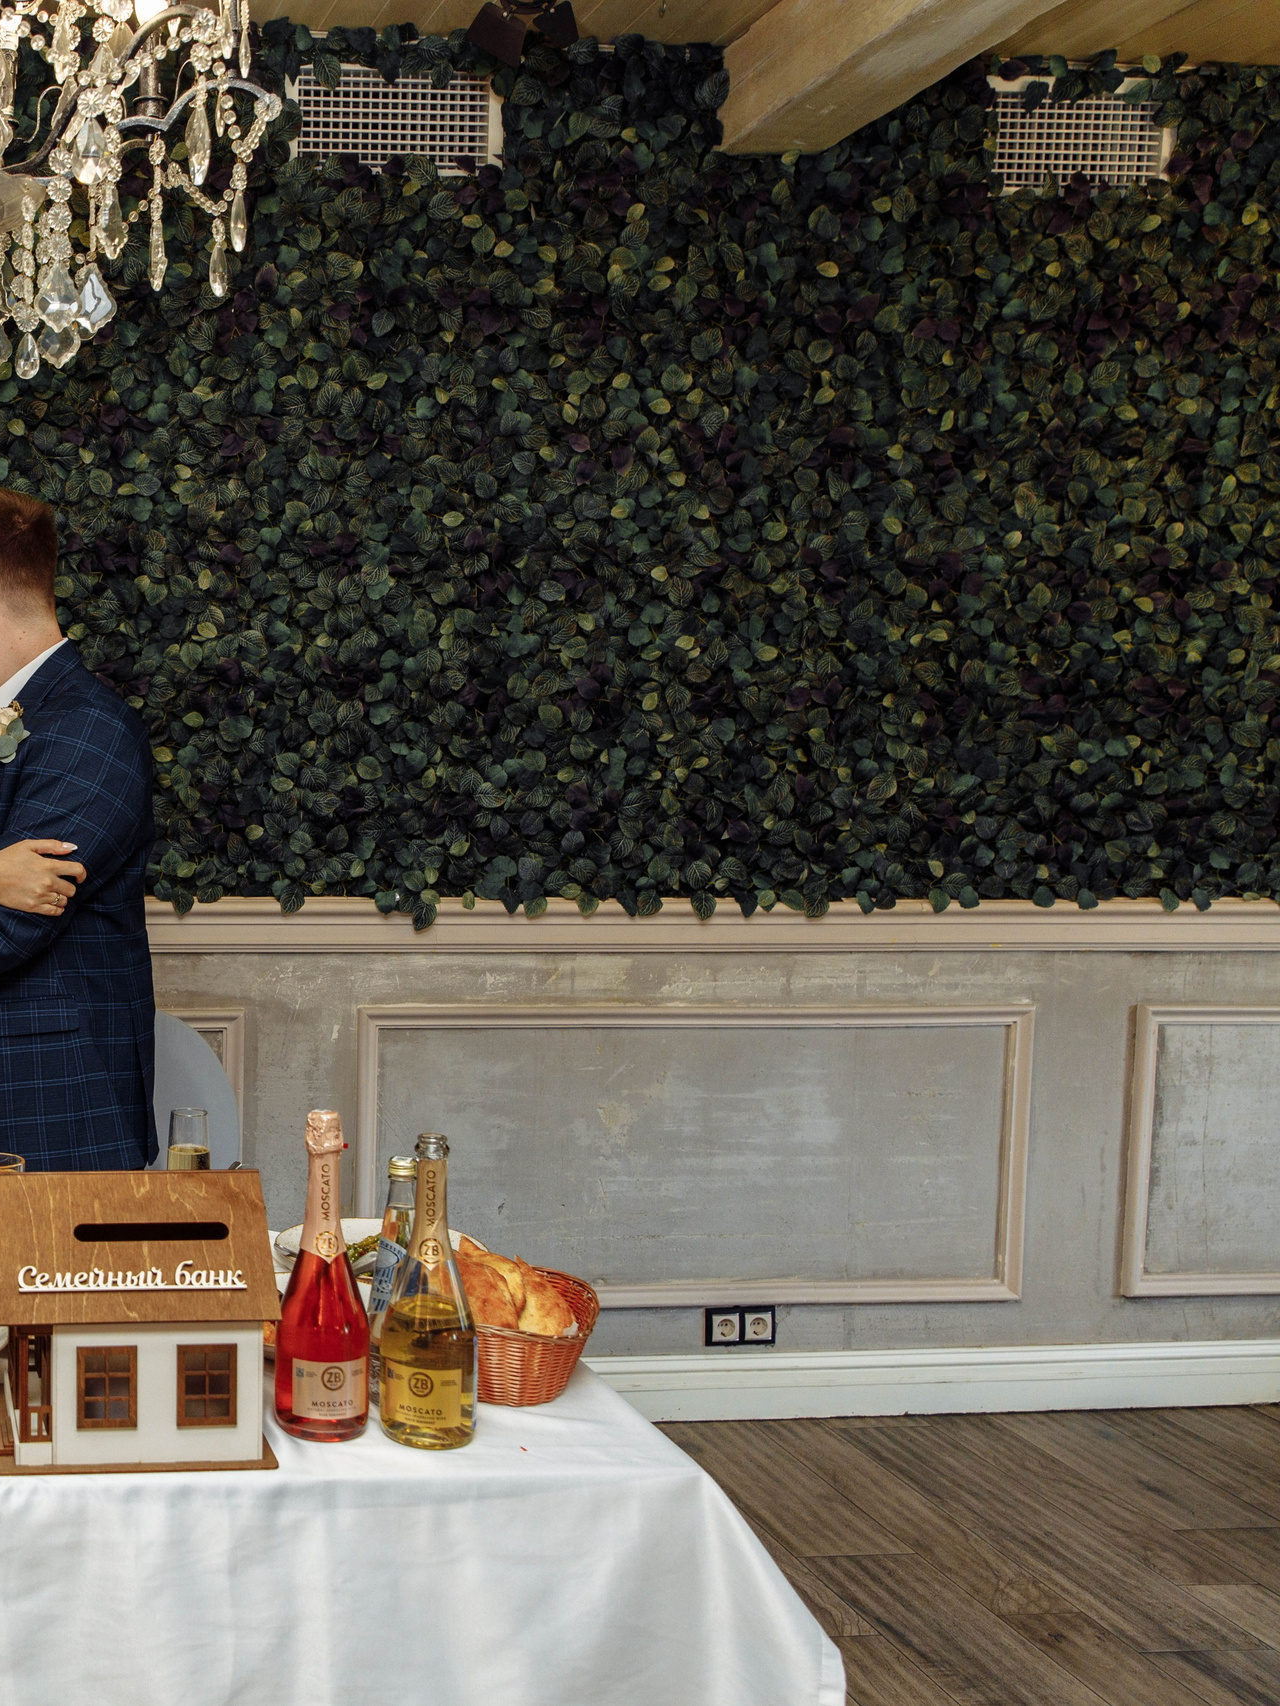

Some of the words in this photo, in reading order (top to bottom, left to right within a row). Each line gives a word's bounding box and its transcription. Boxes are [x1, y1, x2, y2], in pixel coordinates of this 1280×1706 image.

[321, 1163, 331, 1221] MOSCATO
[425, 1169, 436, 1227] MOSCATO
[321, 1237, 335, 1249] ZB
[424, 1243, 439, 1256] ZB
[18, 1265, 167, 1289] Семейный
[175, 1260, 246, 1287] банк
[326, 1371, 341, 1383] ZB
[413, 1377, 429, 1390] ZB
[311, 1399, 354, 1408] MOSCATO
[399, 1404, 443, 1416] MOSCATO
